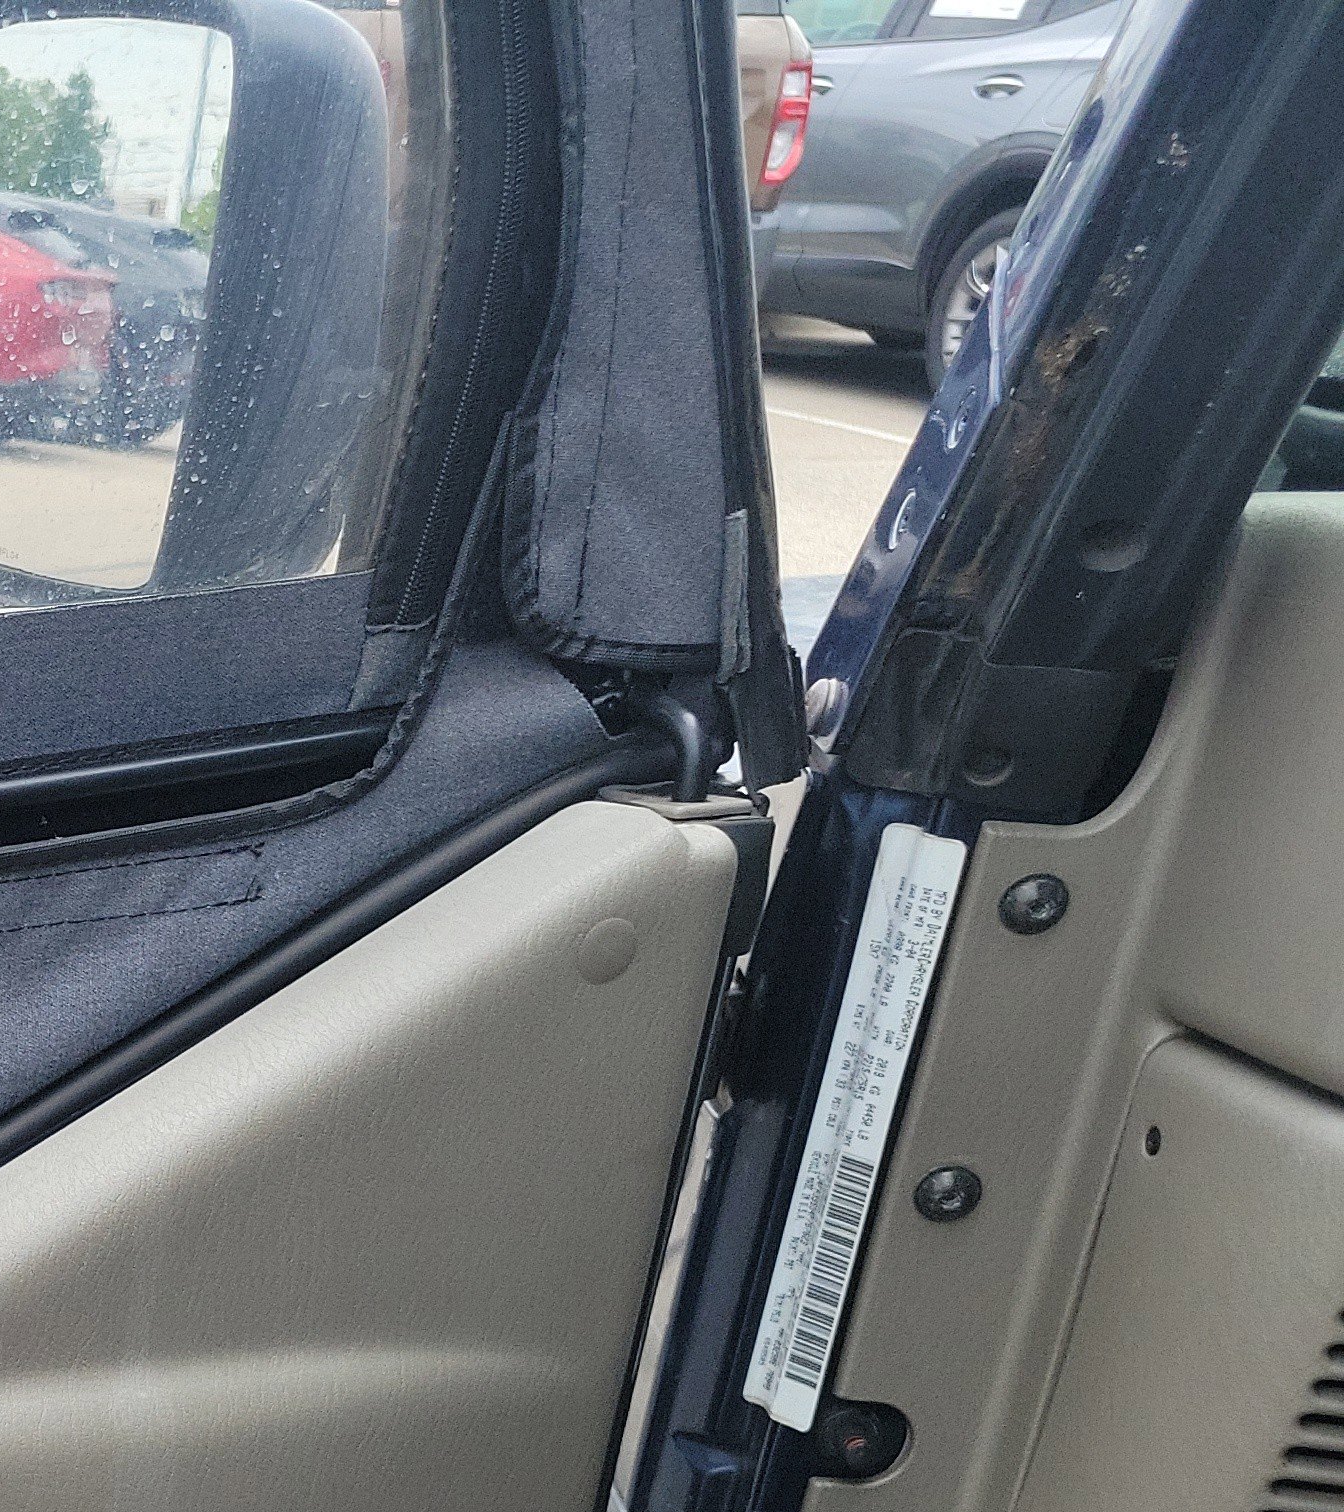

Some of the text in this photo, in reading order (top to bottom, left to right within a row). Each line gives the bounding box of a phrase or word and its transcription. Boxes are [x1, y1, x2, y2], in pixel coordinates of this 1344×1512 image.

[918, 885, 933, 903] DATE
[932, 888, 949, 907] MFD
[928, 906, 944, 921] BY
